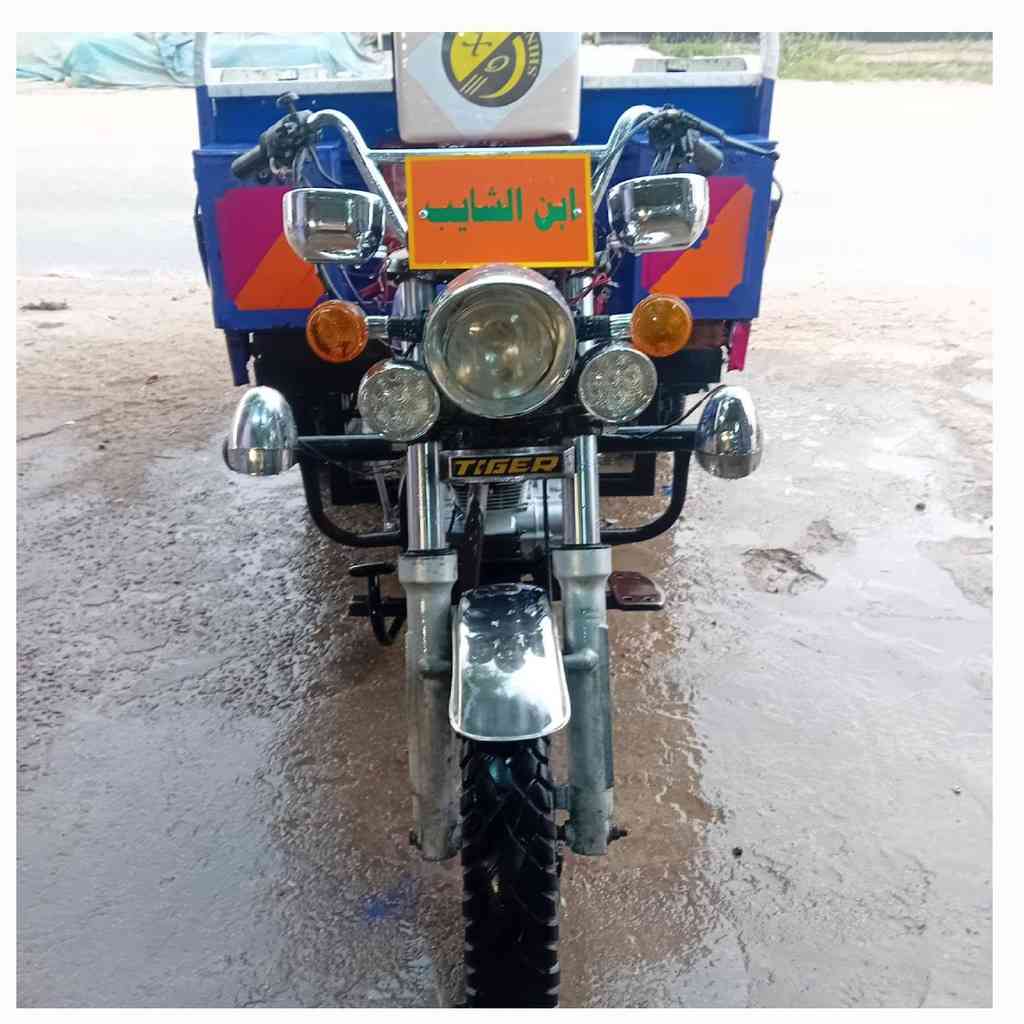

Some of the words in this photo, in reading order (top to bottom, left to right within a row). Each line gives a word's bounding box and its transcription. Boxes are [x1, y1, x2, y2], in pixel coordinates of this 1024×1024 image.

[424, 187, 523, 232] الشايب
[533, 187, 580, 232] ابن
[453, 454, 561, 478] TIGER
